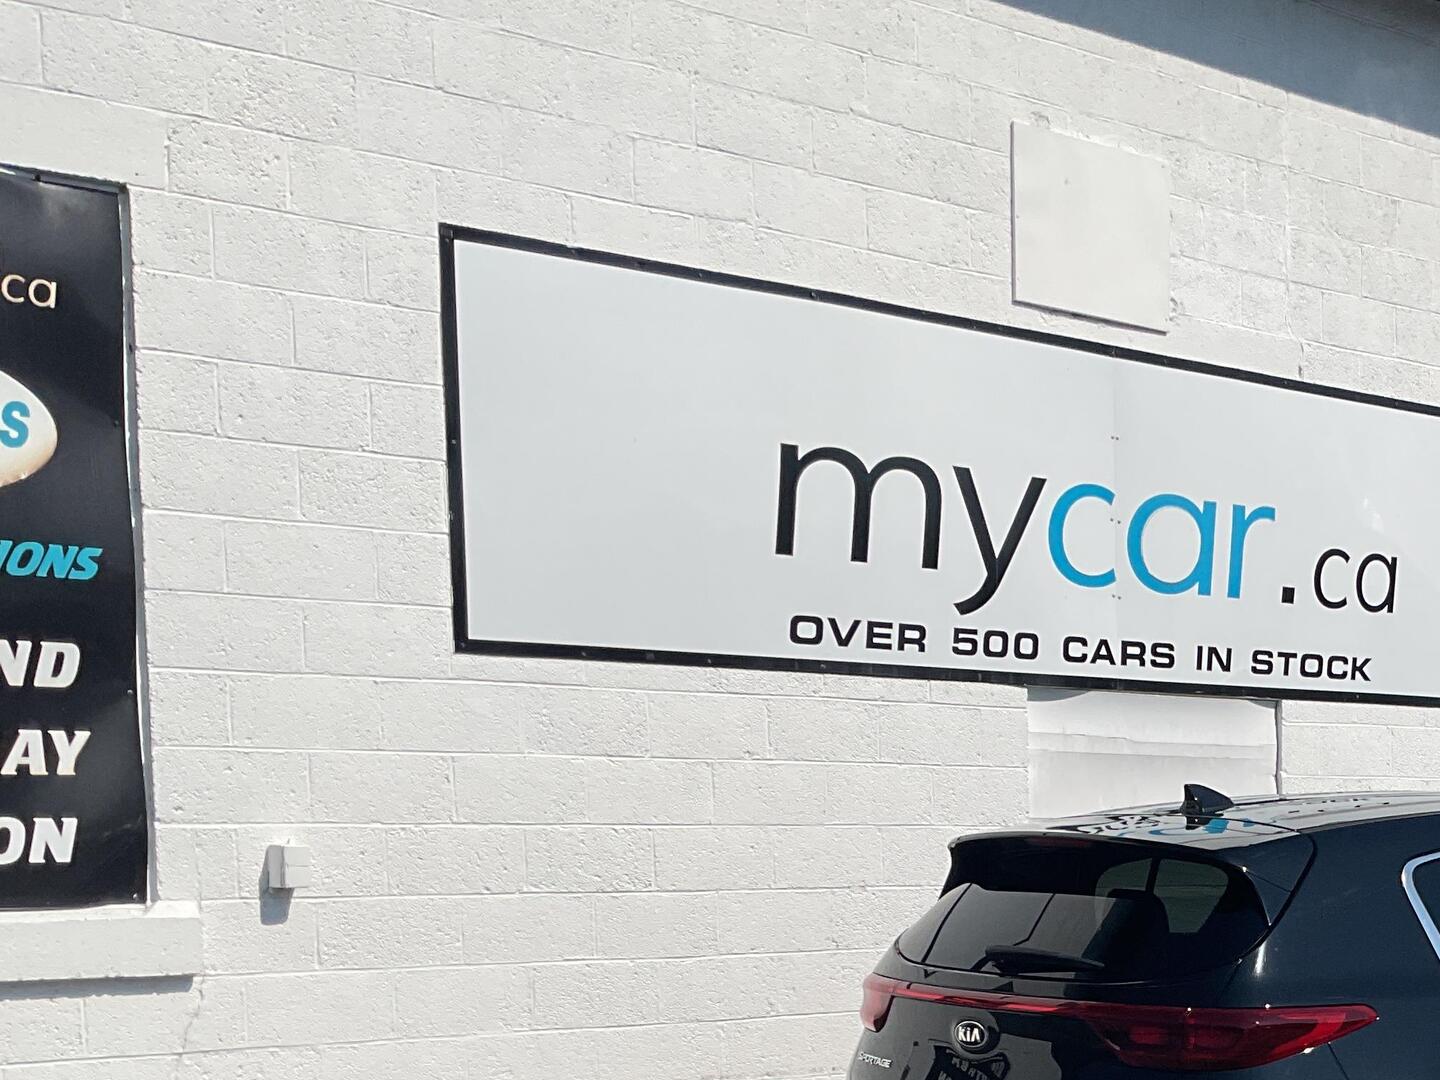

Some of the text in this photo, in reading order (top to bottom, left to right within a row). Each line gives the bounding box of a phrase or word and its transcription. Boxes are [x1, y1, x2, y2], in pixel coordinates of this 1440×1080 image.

[789, 615, 1373, 681] OVER 500 CARS IN STOCK
